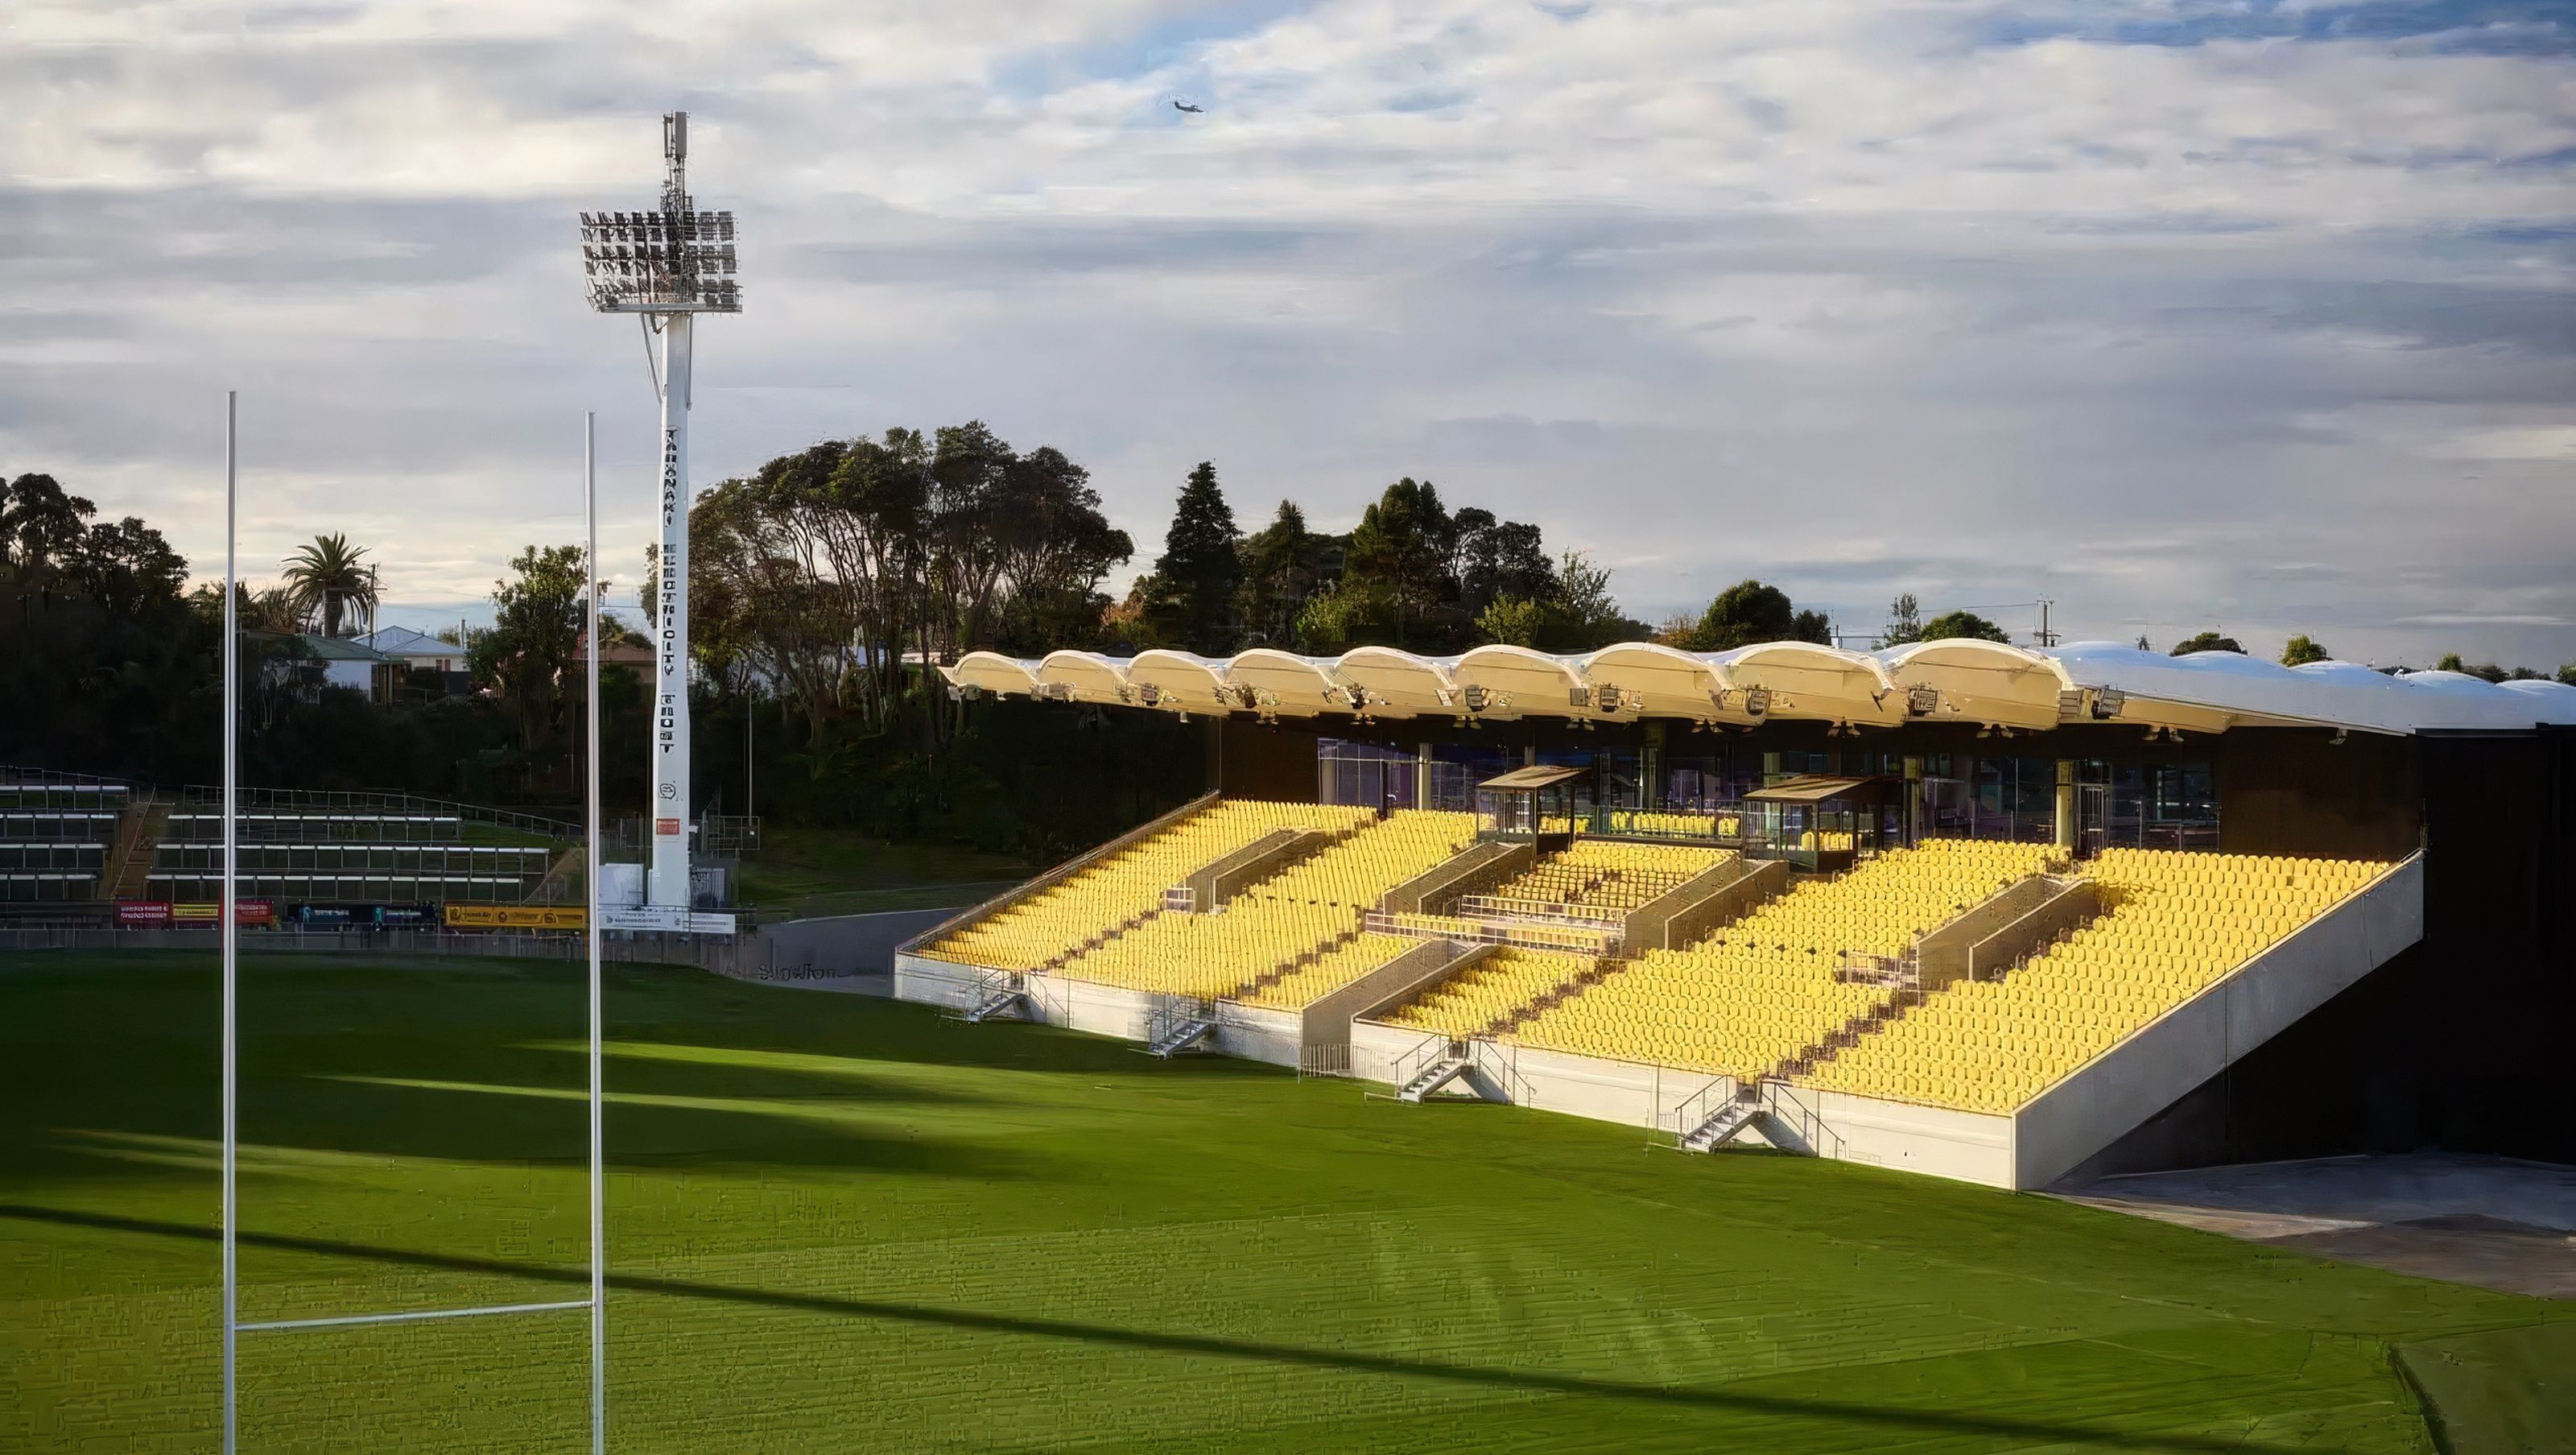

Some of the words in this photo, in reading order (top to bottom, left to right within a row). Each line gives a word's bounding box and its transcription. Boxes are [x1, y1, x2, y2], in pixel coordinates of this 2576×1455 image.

[663, 428, 678, 526] TARANAKI
[663, 544, 676, 676] ELECTRICITY
[659, 693, 675, 754] TRUST
